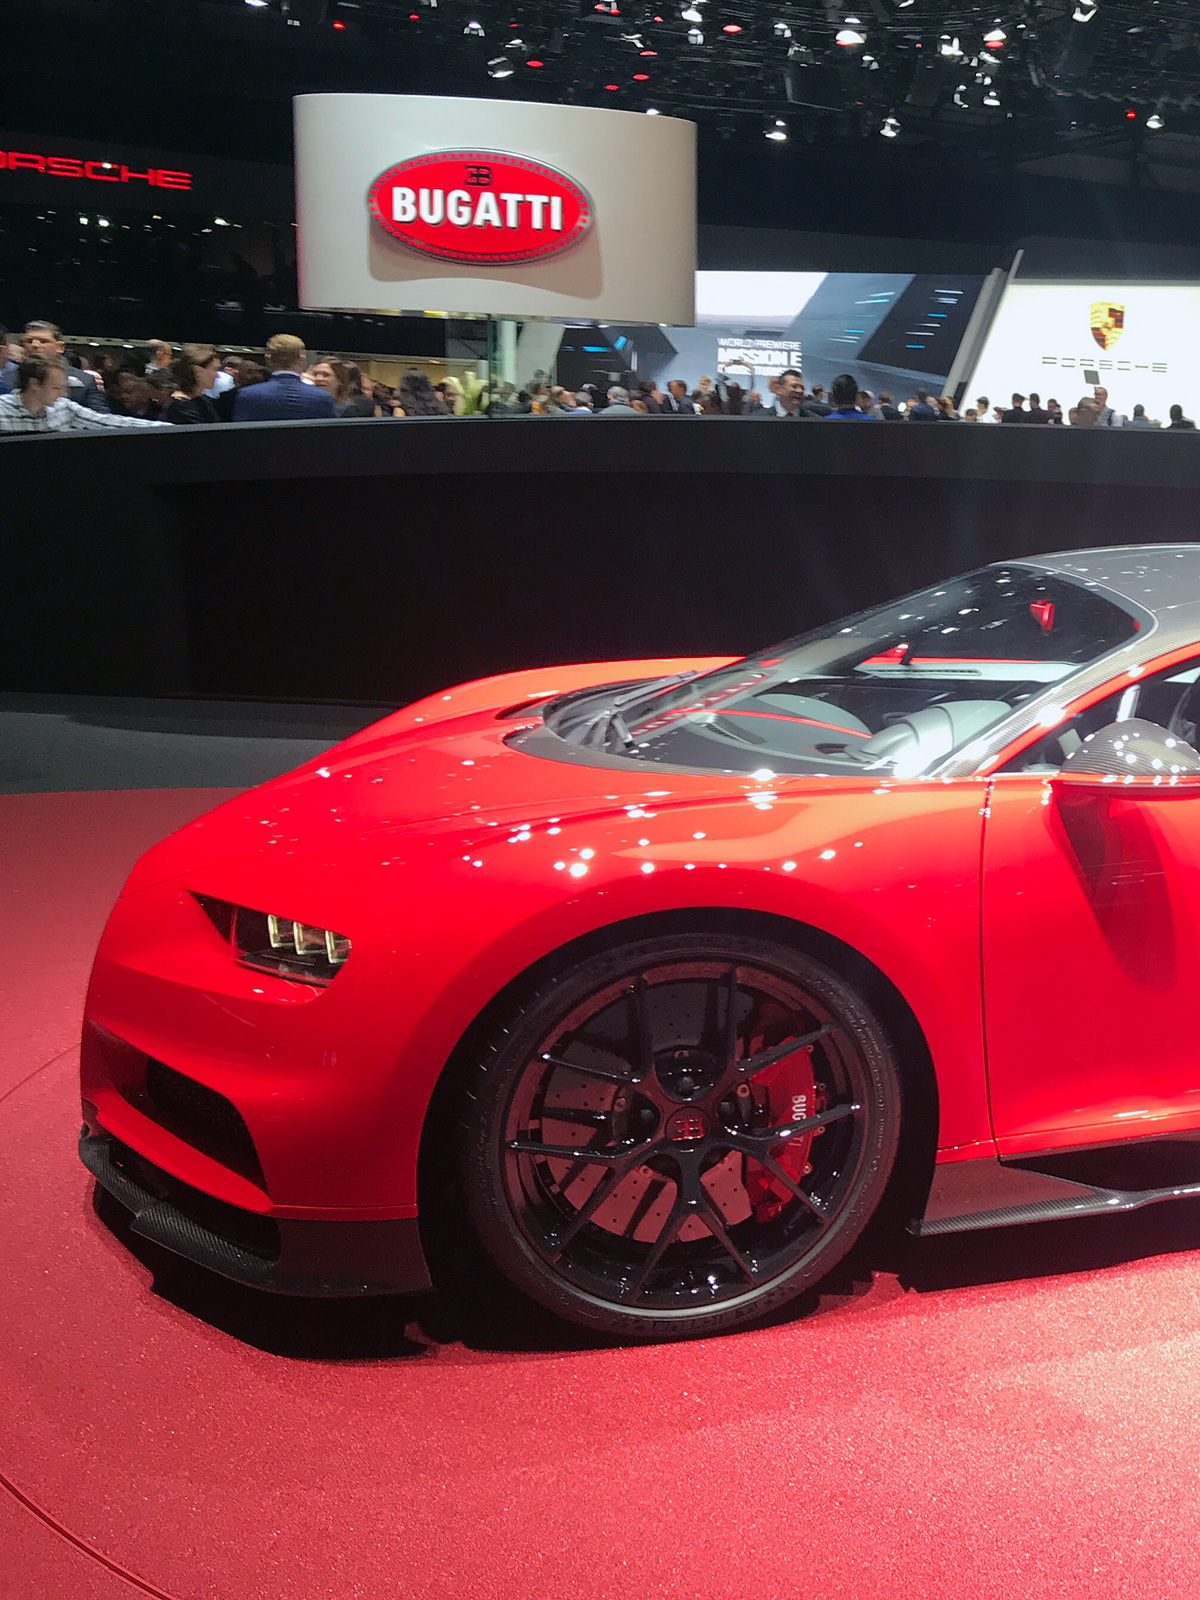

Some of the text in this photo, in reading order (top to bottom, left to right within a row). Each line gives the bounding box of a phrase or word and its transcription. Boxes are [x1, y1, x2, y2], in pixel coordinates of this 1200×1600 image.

[0, 151, 192, 190] RSCHE
[392, 186, 563, 232] BUGATTI
[717, 348, 802, 366] MISSION E
[789, 1094, 807, 1147] BUGTI
